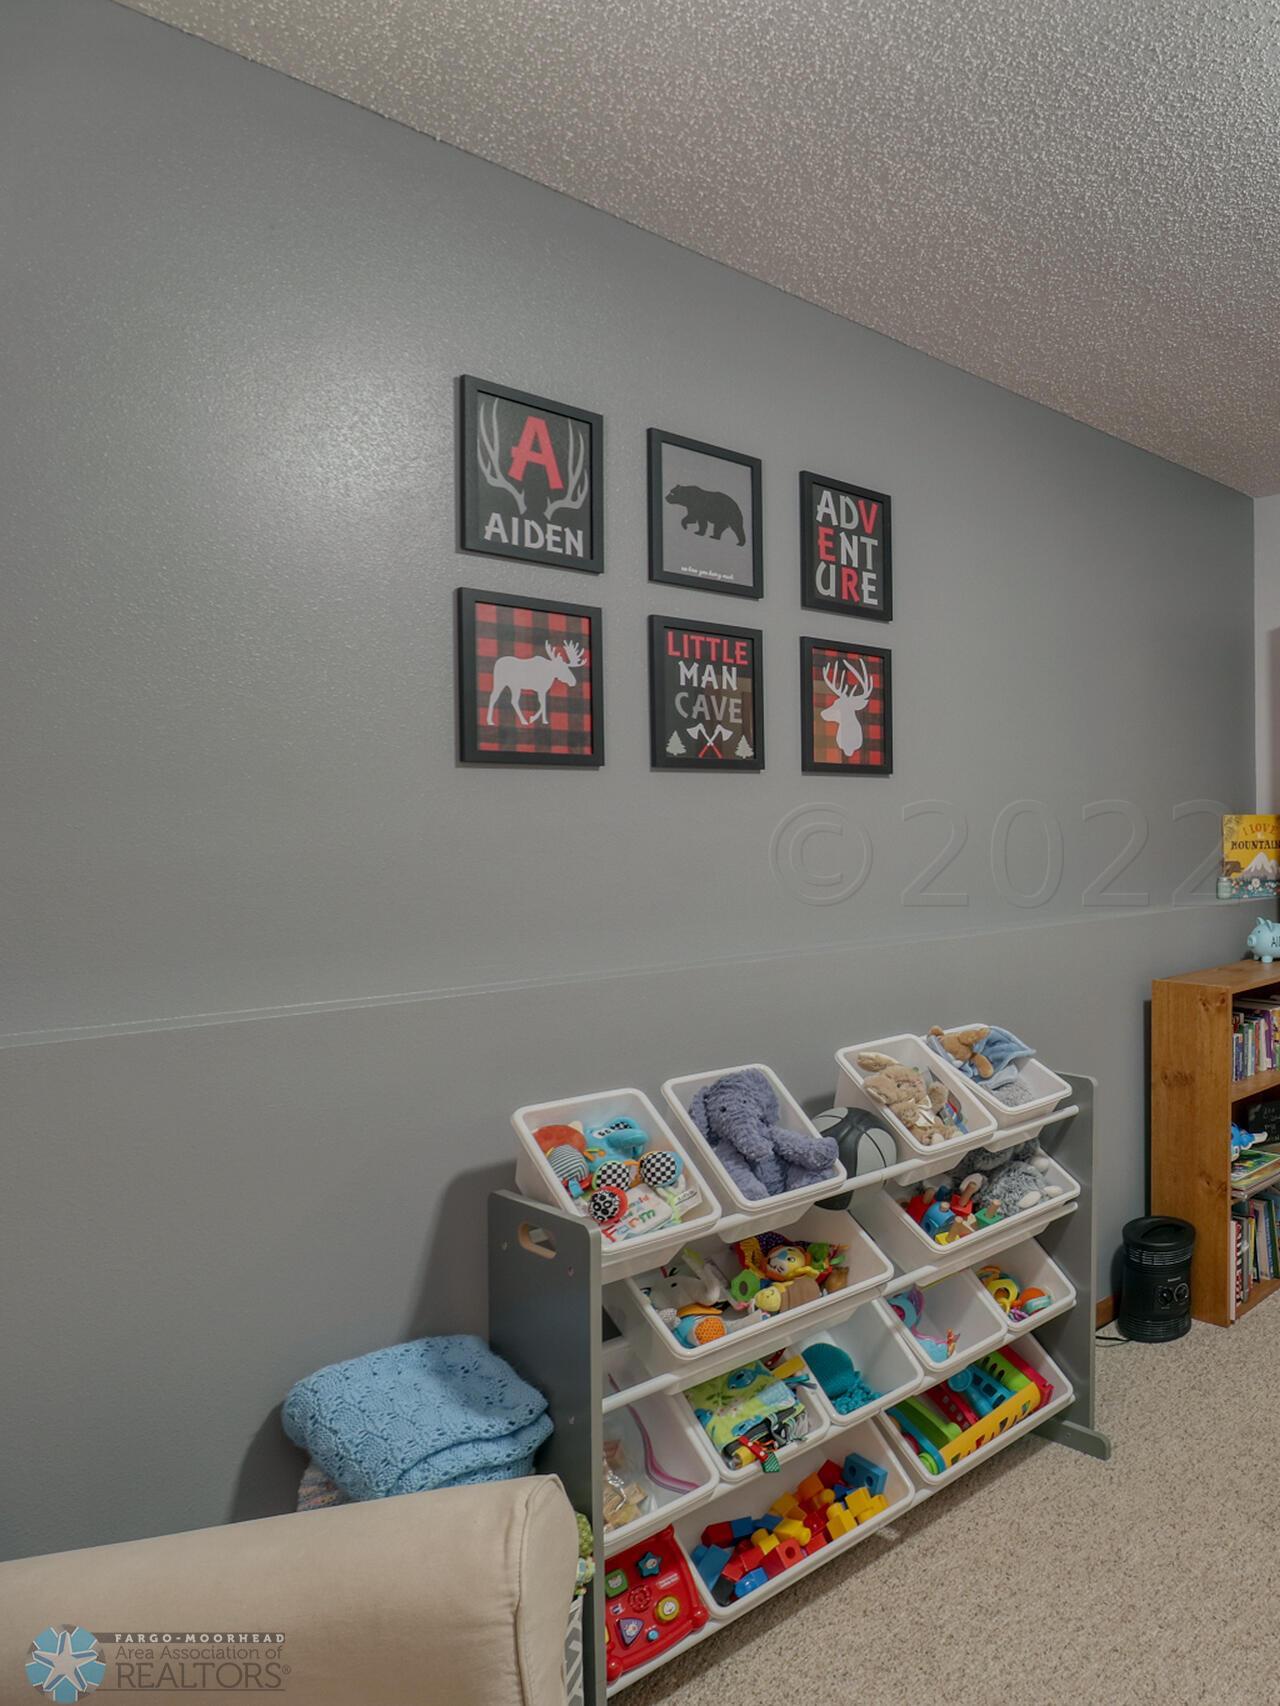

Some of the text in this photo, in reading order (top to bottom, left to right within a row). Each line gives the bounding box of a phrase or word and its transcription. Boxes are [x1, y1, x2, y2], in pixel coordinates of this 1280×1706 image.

[508, 415, 564, 490] A
[484, 511, 584, 558] AIDEN
[667, 630, 749, 665] LITTLE
[679, 661, 738, 691] MAN
[674, 692, 743, 724] CAVE
